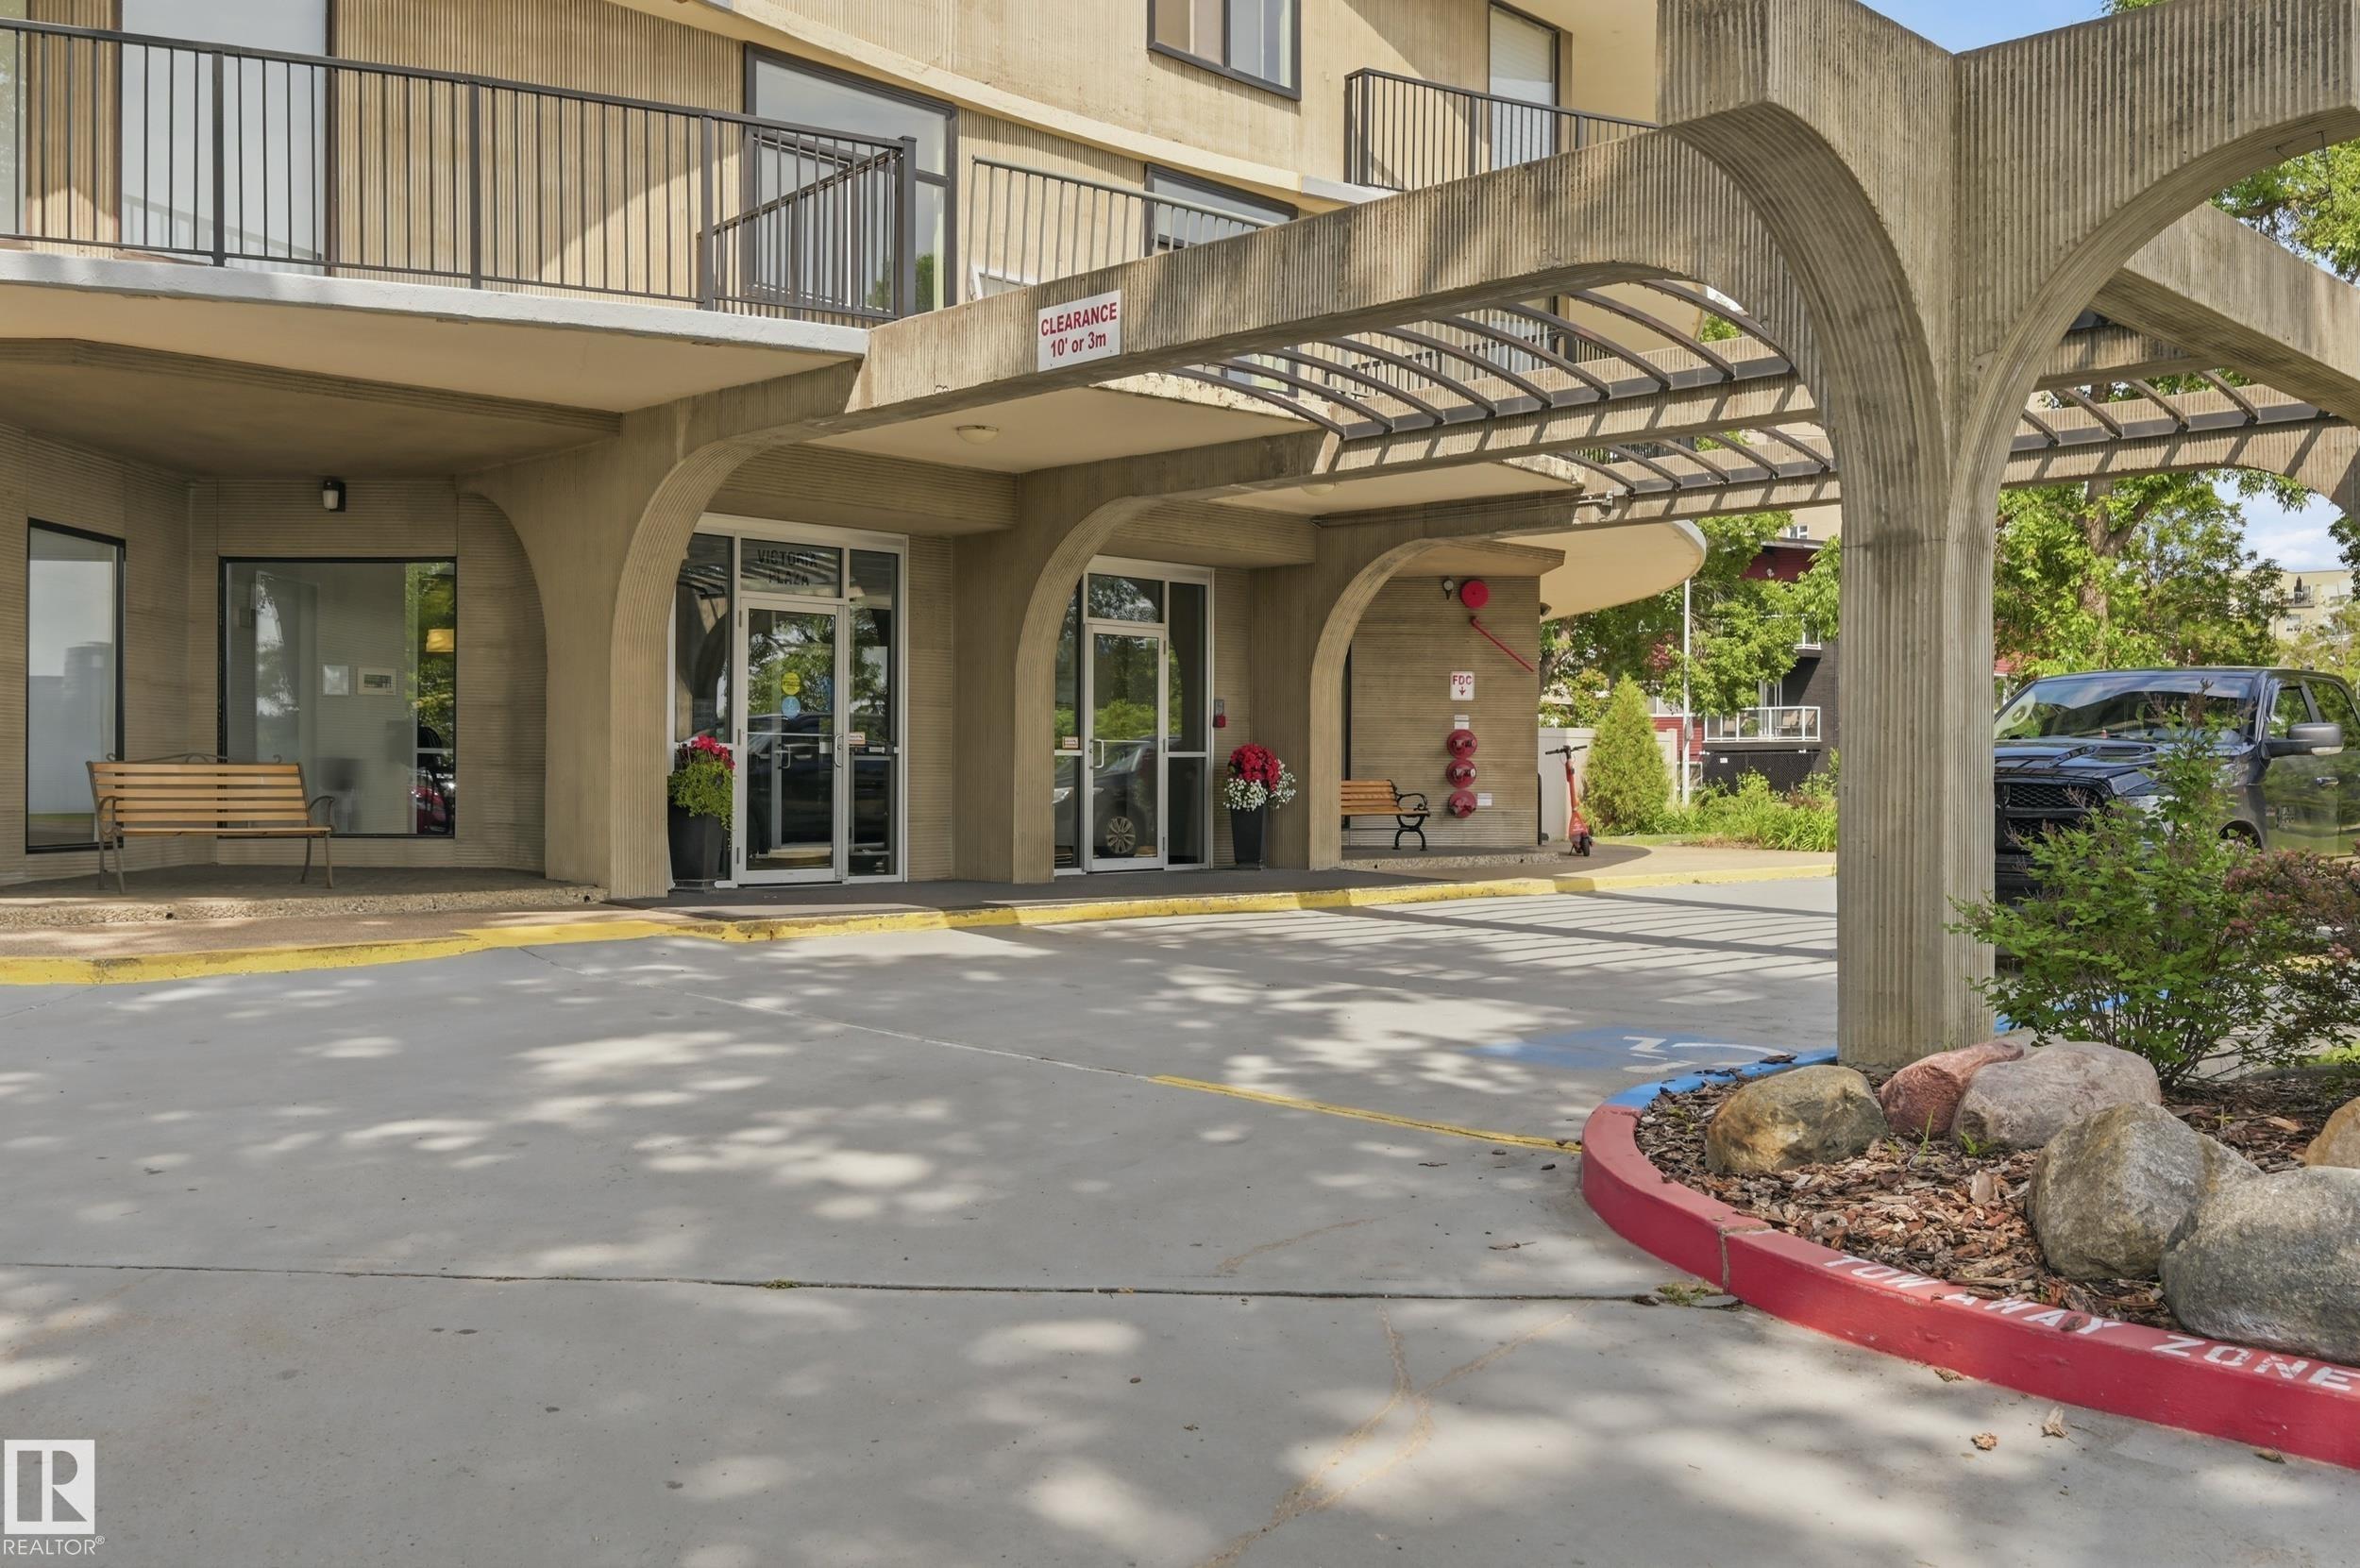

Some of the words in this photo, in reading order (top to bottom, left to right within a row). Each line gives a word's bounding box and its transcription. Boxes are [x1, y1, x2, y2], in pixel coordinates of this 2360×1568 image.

[1040, 302, 1118, 336] CLEARANCE
[1051, 337, 1068, 358] 10'
[1071, 338, 1085, 354] or
[1087, 331, 1106, 350] 3m
[757, 549, 818, 567] VICTORIA
[1452, 675, 1473, 685] FDC
[1824, 1255, 1939, 1288] TOW
[1944, 1293, 2123, 1335] AWAY
[2151, 1335, 2360, 1391] ZONE
